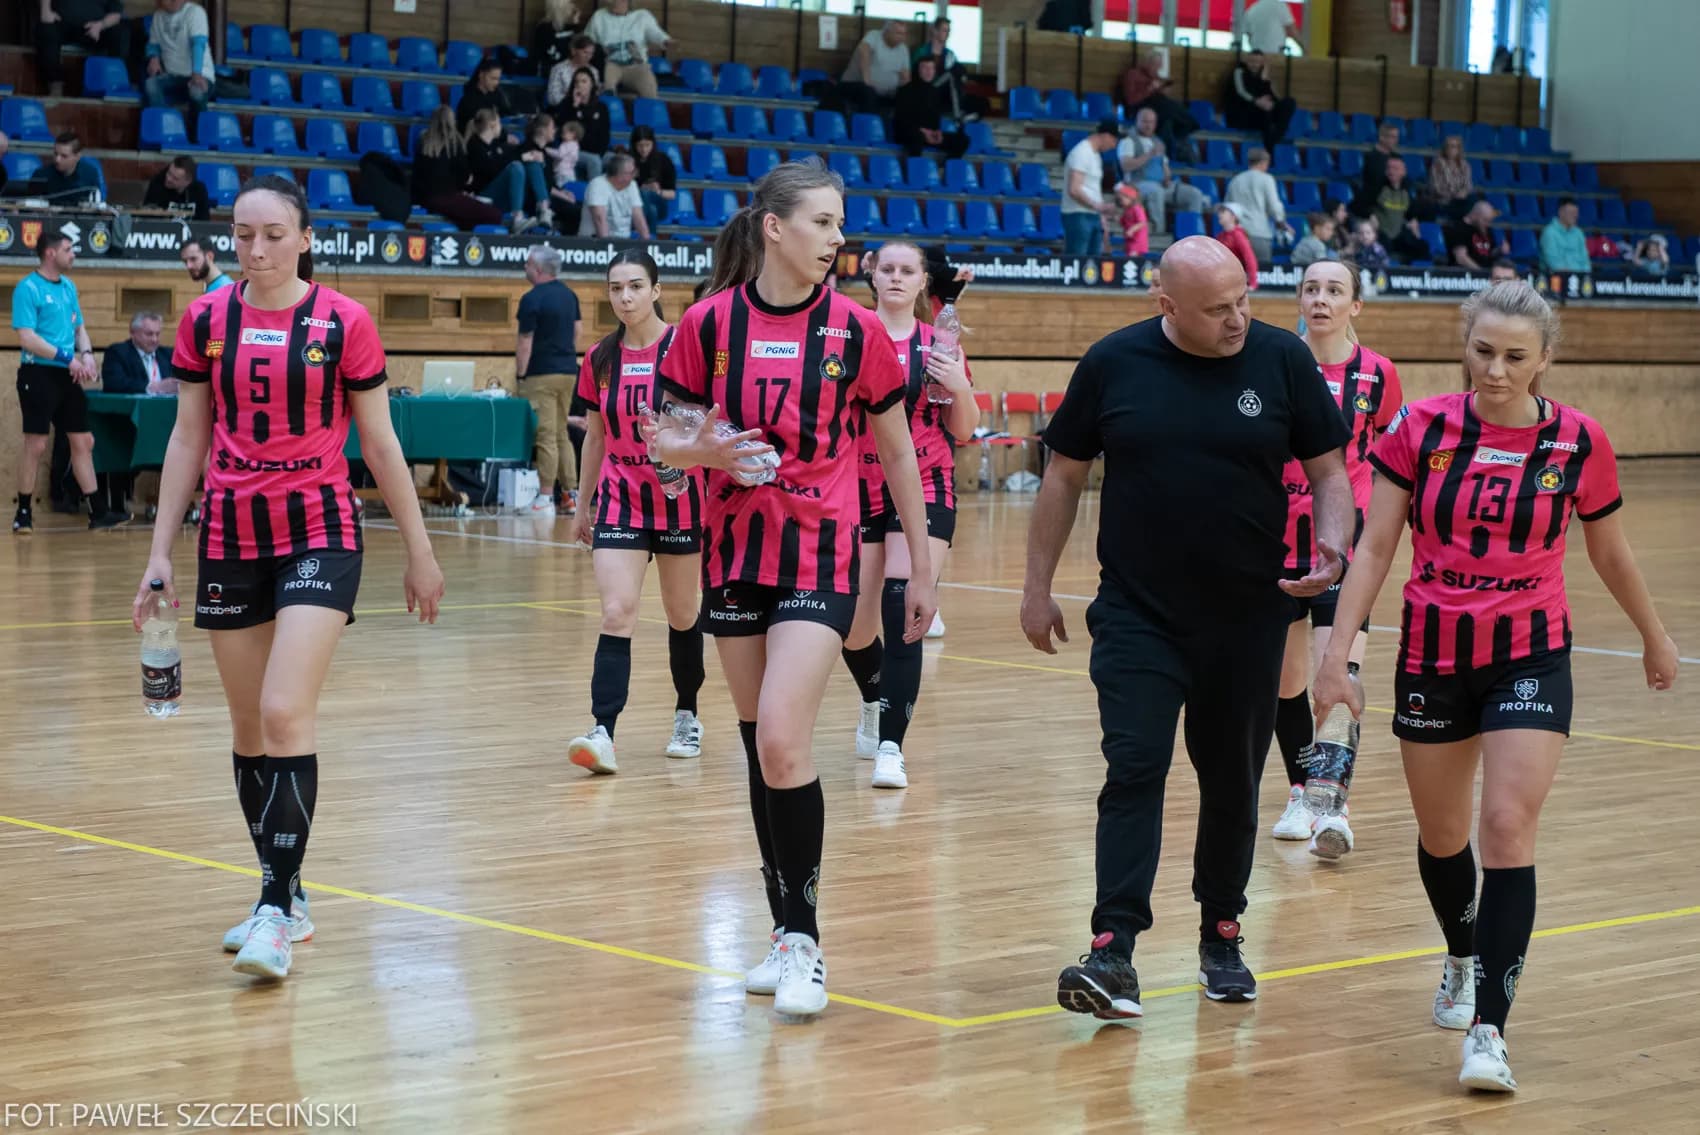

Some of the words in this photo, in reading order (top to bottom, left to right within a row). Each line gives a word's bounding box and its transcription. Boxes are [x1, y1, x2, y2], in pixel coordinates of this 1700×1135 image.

[250, 357, 271, 404] 5
[754, 377, 791, 426] 17
[234, 456, 324, 473] SUZUKI
[1467, 473, 1512, 523] 13
[284, 579, 332, 591] PROFIKA
[778, 600, 827, 611] PROFIKA
[710, 609, 758, 621] karabela
[1500, 702, 1554, 714] PROFIKA
